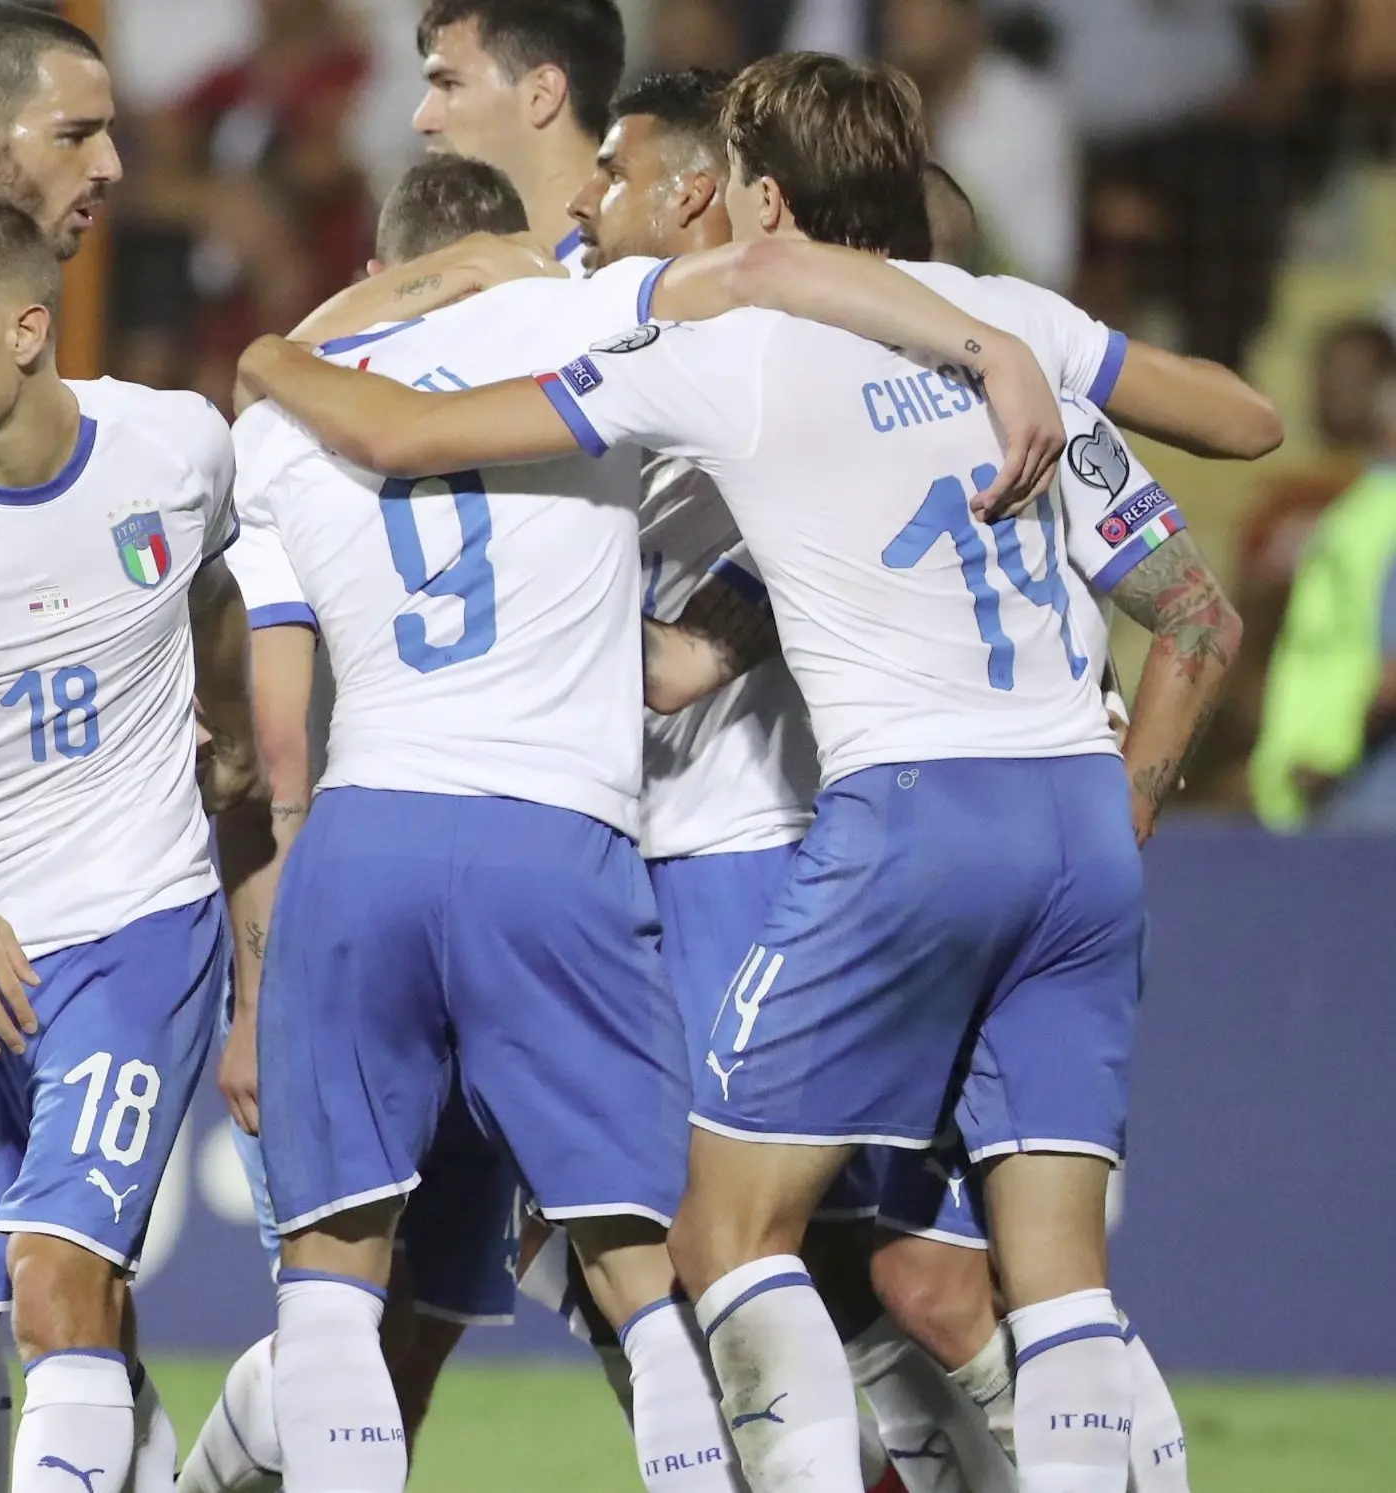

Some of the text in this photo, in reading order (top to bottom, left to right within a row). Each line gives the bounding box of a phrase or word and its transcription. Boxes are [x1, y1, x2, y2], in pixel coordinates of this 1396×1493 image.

[567, 359, 596, 389] SPECT
[1122, 488, 1167, 526] RESPEC
[378, 469, 497, 674] 9
[881, 462, 1089, 691] 14
[0, 665, 100, 763] 18
[63, 1051, 161, 1167] 18
[329, 1426, 404, 1443] ITALIA
[1050, 1413, 1132, 1435] ITALIA
[644, 1447, 723, 1477] ITALIA
[1152, 1436, 1187, 1466] ITA
